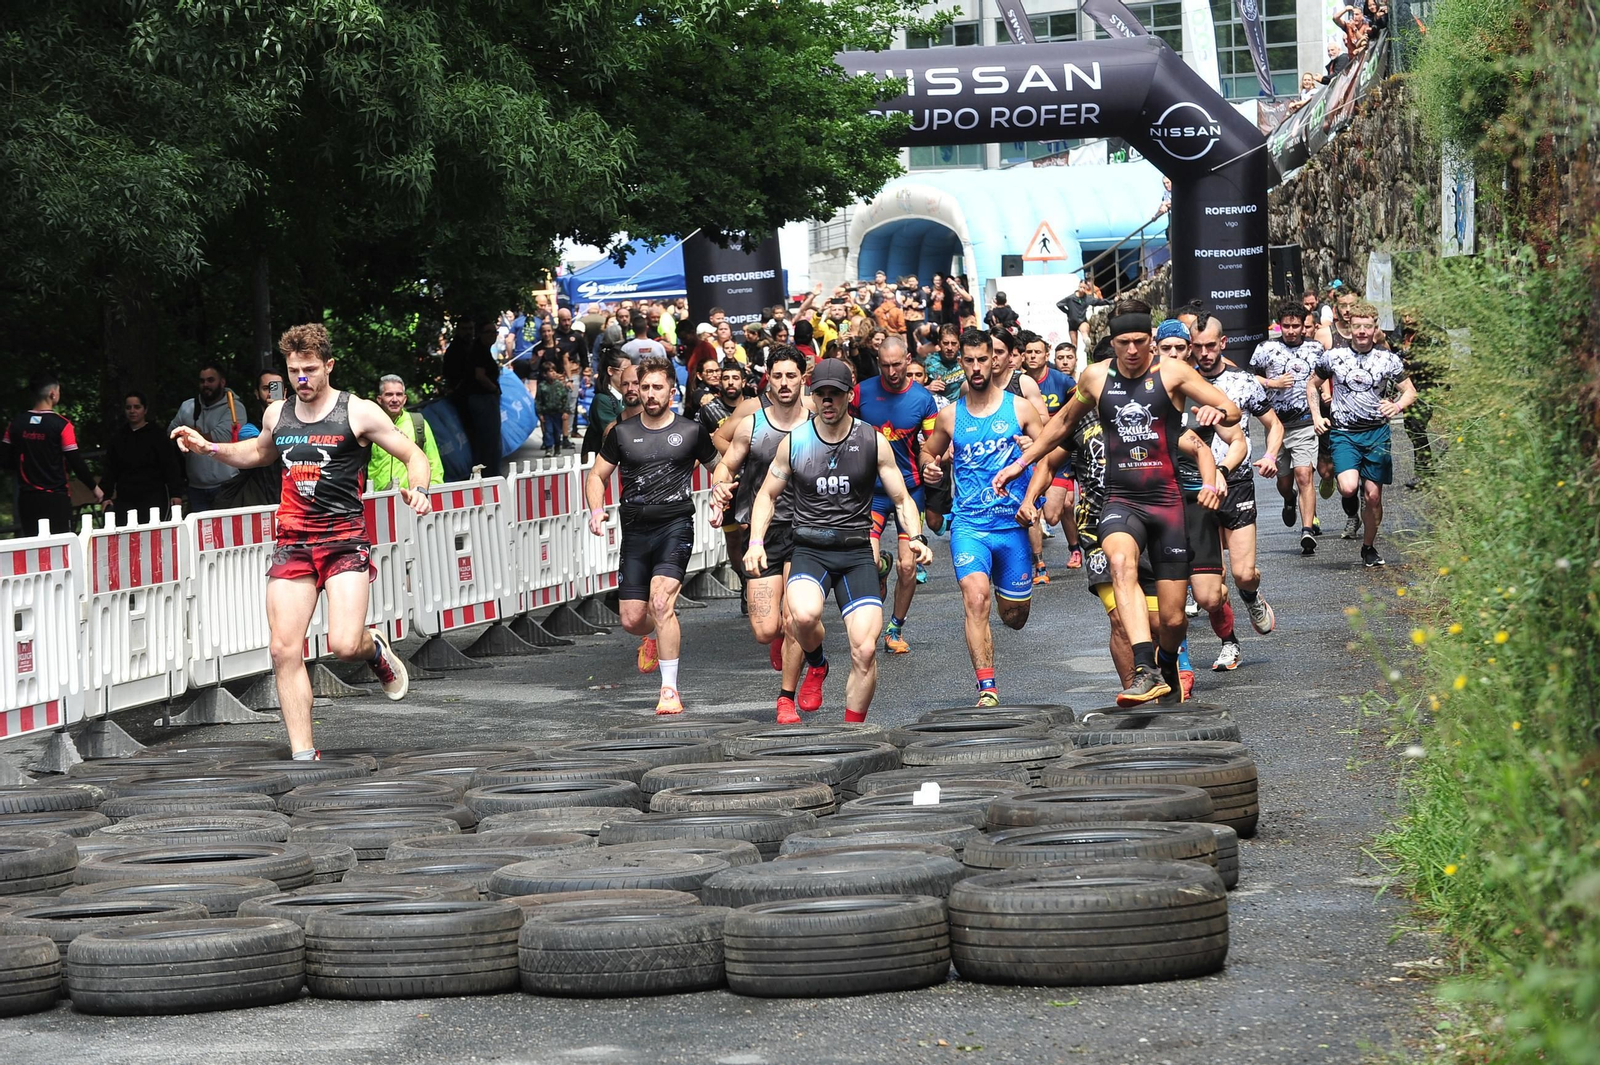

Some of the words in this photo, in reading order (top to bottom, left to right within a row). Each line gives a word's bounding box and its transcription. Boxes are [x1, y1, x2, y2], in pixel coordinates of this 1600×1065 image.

[866, 107, 980, 132] UPO
[990, 102, 1101, 129] ROFER
[1150, 124, 1222, 138] NISSAN
[1205, 204, 1257, 215] ROFERVIGO
[1224, 220, 1239, 228] Vigo
[729, 243, 742, 251] Vig
[1194, 246, 1264, 258] ROFEROURENSE
[702, 269, 776, 283] ROFEROURENSE
[1210, 289, 1252, 299] ROIPESA
[1117, 425, 1152, 436] SKULL
[962, 437, 1007, 456] 1336
[290, 465, 321, 474] BRAVE
[291, 473, 321, 482] BULLS
[816, 475, 851, 495] 885
